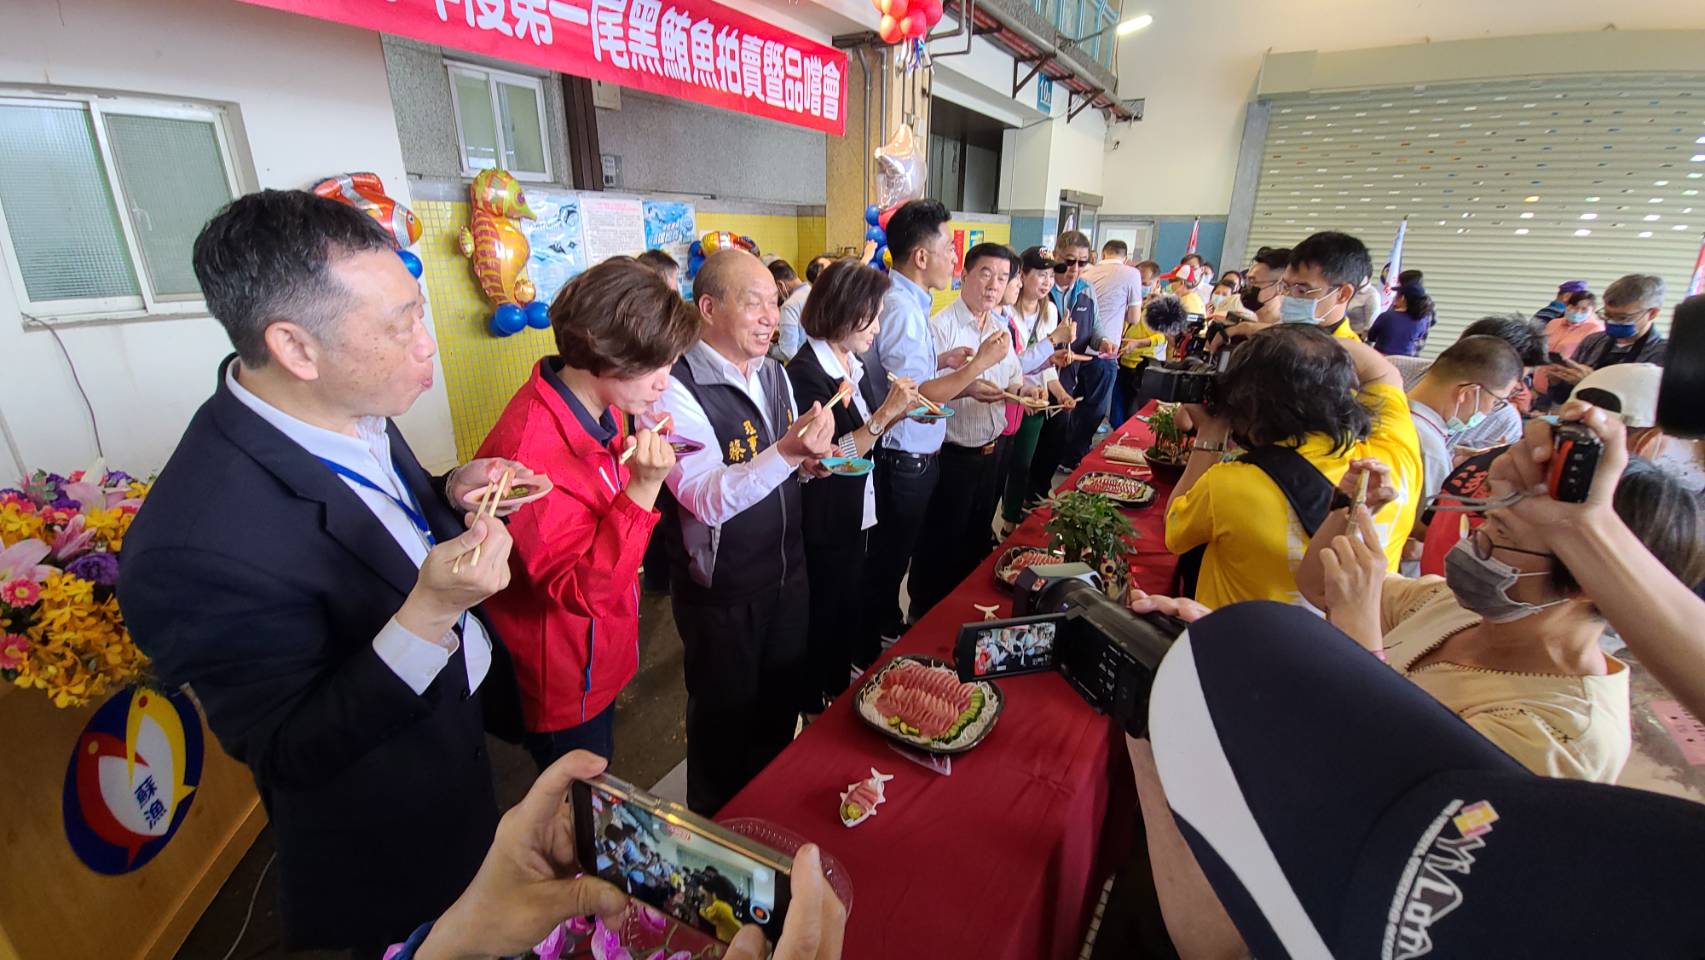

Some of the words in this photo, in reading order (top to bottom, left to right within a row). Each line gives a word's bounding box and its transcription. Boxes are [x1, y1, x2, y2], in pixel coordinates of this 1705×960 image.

[436, 0, 840, 121] 第一尾黑鮪魚拍賣暨品嚐會
[134, 774, 168, 830] 蘇漁
